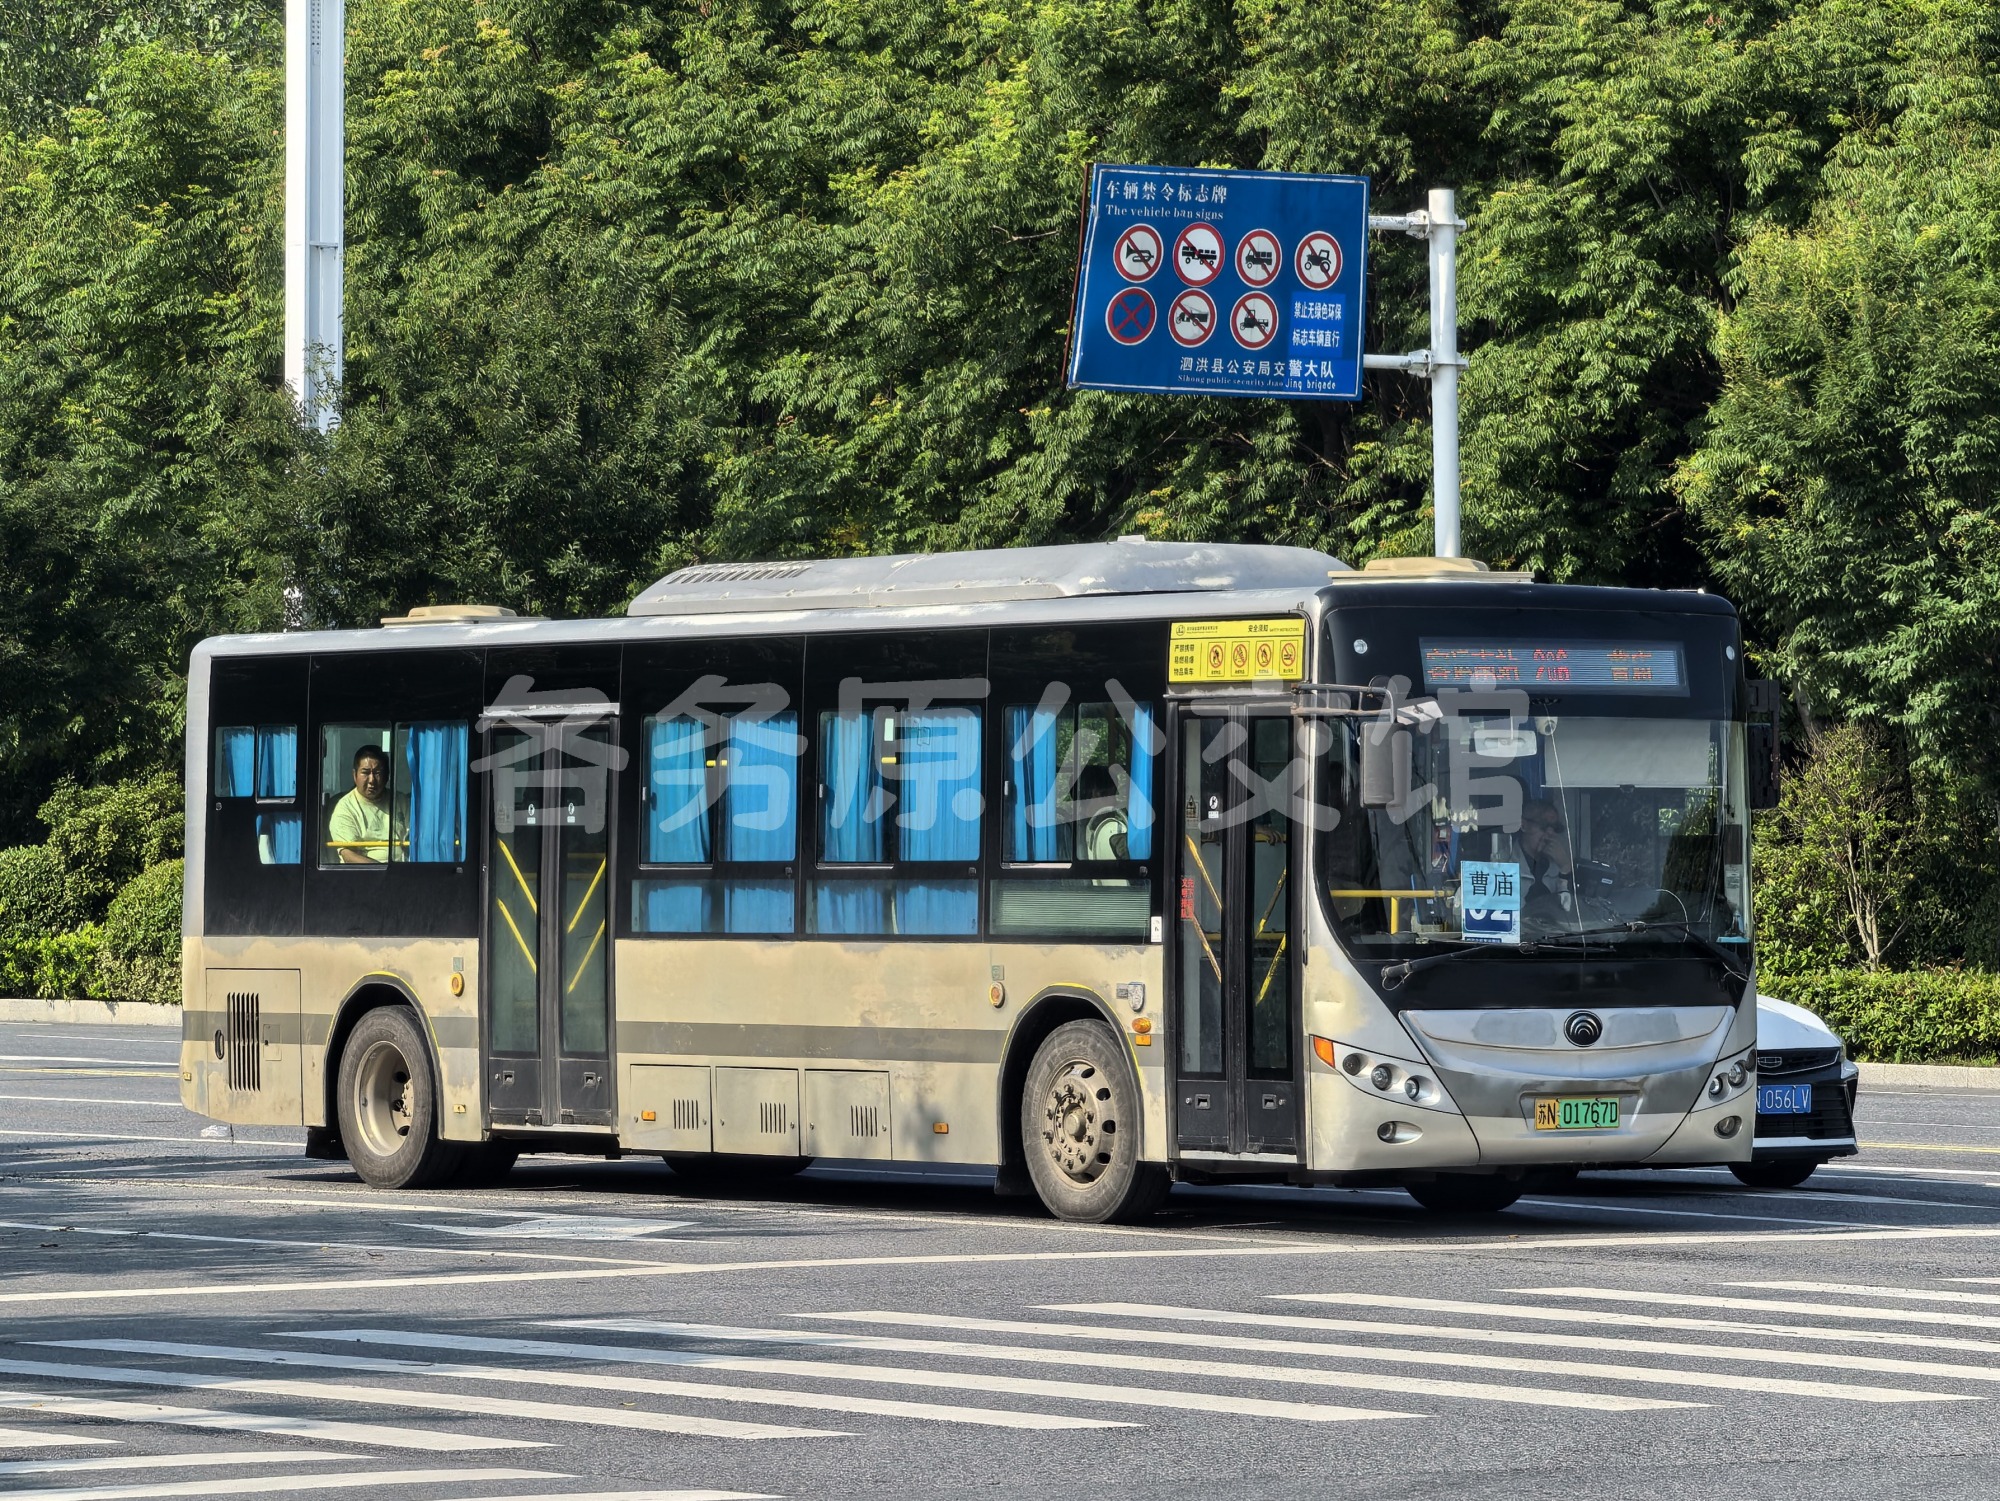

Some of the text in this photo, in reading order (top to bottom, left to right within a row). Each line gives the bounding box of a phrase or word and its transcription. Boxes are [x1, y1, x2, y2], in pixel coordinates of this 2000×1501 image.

[1104, 180, 1227, 204] 车辆禁令标志牌
[1105, 204, 1224, 221] The vehicle ban signs
[1293, 301, 1342, 321] 禁止无绿色环保
[1292, 328, 1340, 347] 标志车辆直行
[1180, 356, 1334, 379] 泗洪县公安局交警大队
[1177, 374, 1205, 384] Sihong
[1206, 376, 1231, 385] public
[1285, 379, 1302, 390] Jing
[1306, 378, 1336, 392] brigade
[1469, 870, 1513, 897] 曹庙
